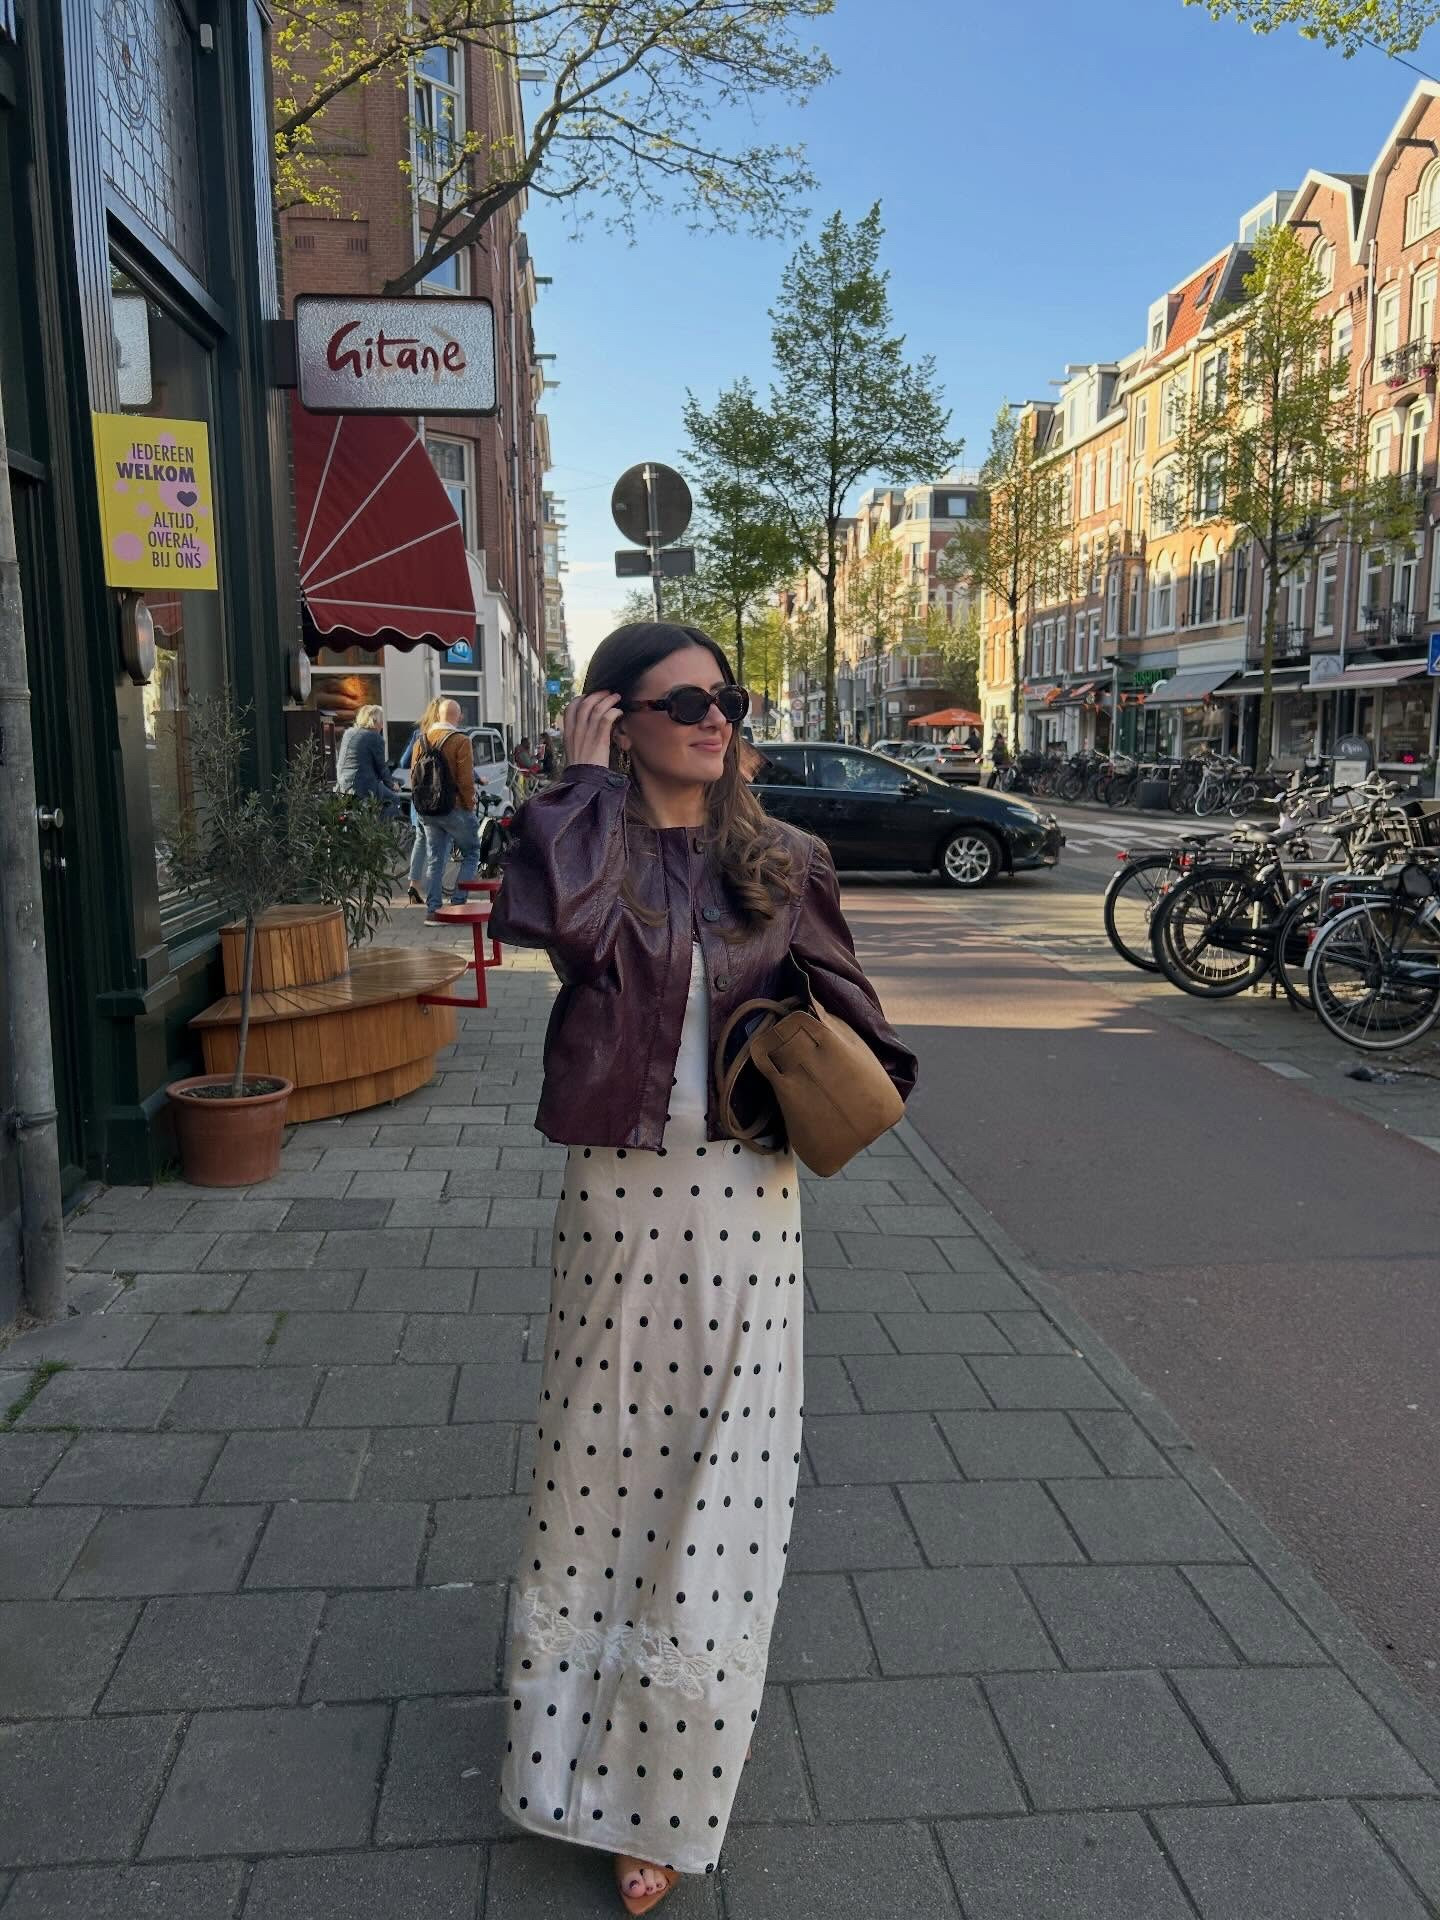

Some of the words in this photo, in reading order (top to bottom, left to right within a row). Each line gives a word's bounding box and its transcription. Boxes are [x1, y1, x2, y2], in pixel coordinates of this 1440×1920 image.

[327, 320, 466, 379] Gitane
[132, 443, 194, 463] IEDEREEN
[116, 461, 196, 483] WELKOM
[153, 511, 199, 533] ALTIJD,
[147, 531, 200, 552] OVERAL,
[152, 552, 170, 568] BIJ
[175, 552, 202, 569] ONS
